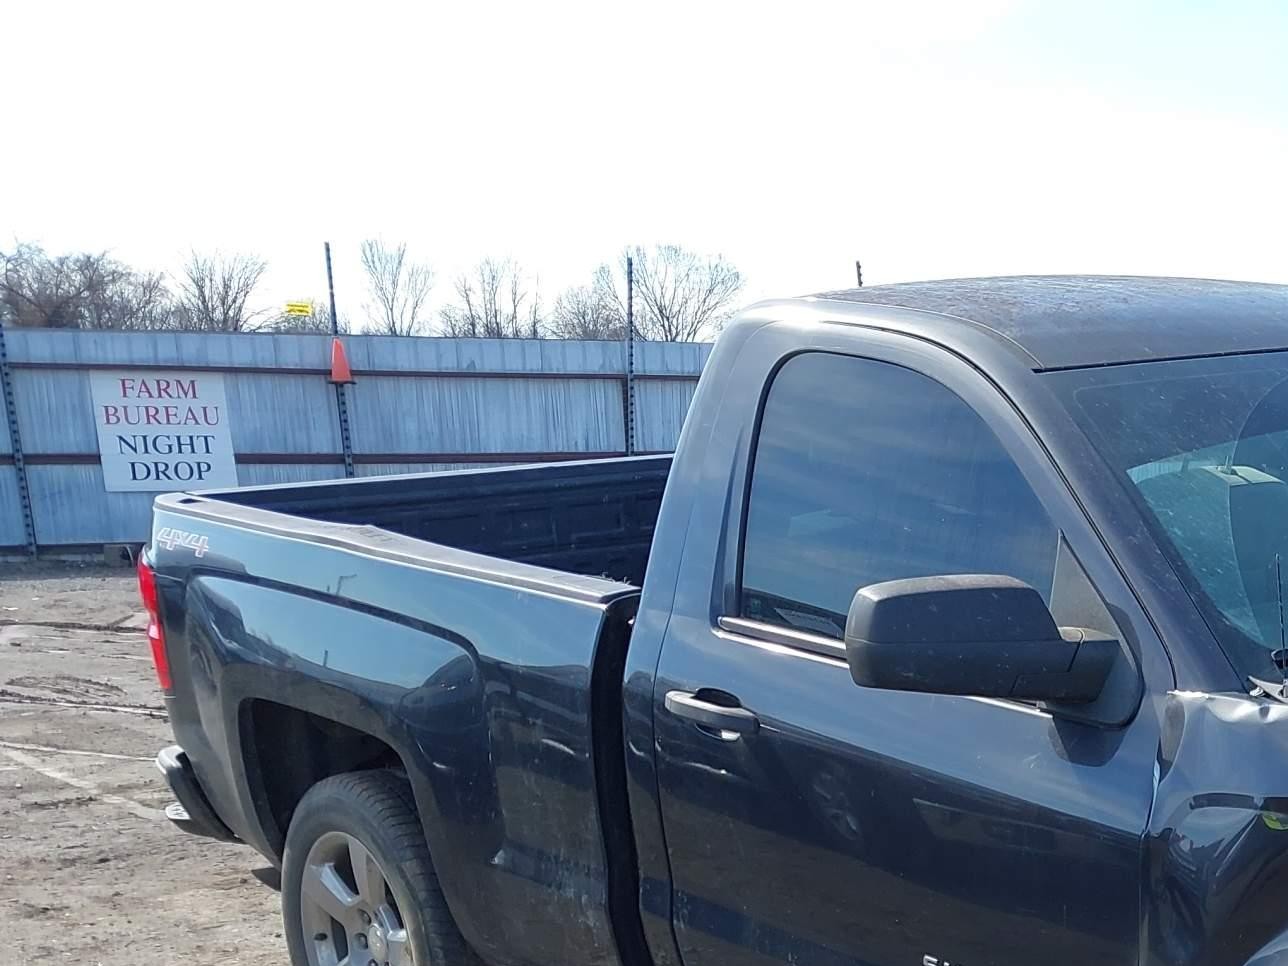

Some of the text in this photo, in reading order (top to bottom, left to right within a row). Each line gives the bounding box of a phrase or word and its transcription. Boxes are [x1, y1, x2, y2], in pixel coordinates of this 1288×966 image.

[119, 378, 199, 400] FARM
[103, 405, 220, 426] BUREAU
[116, 434, 216, 455] NIGHT
[128, 461, 212, 481] DROP
